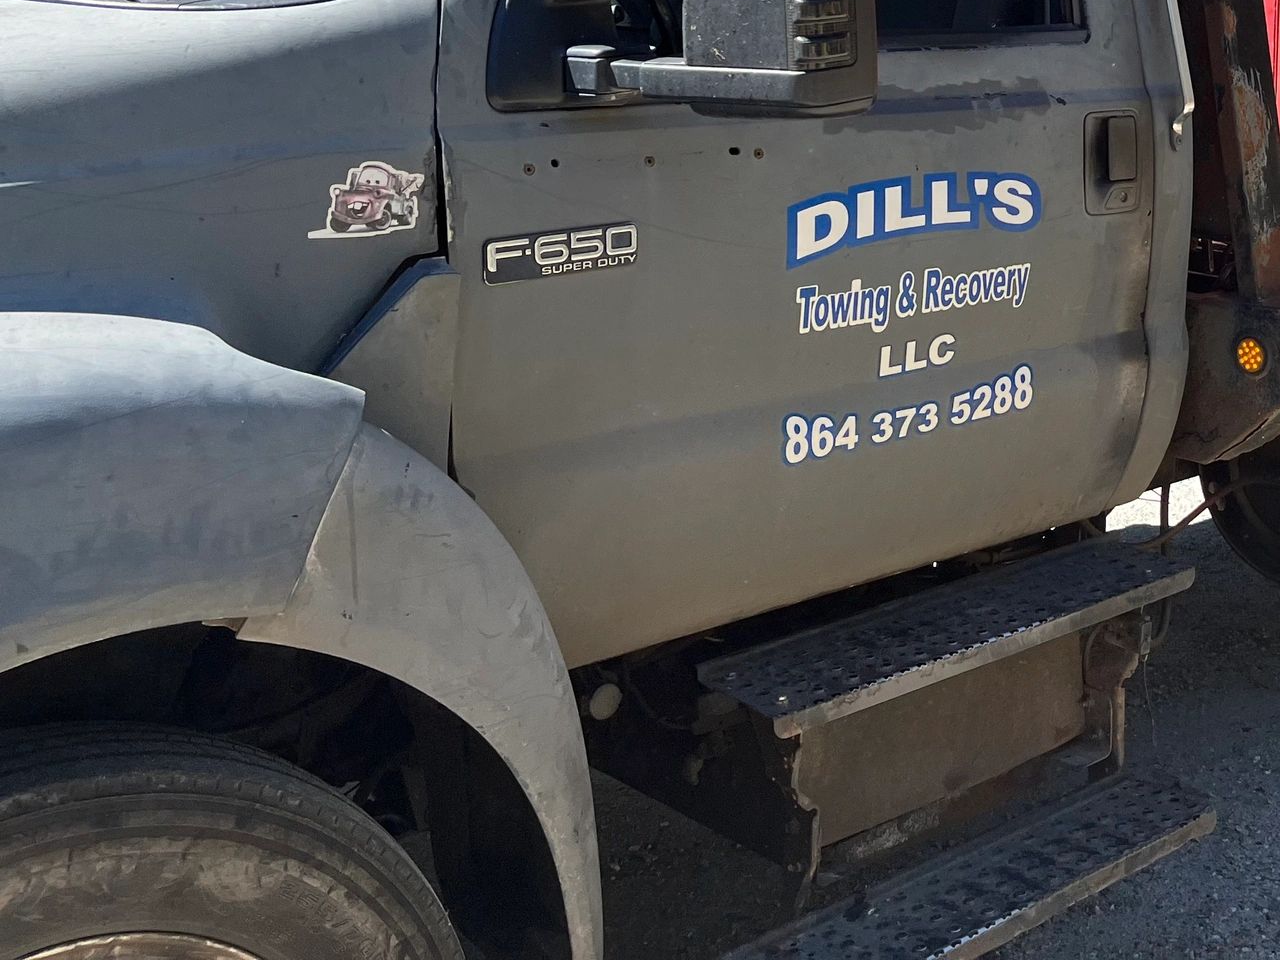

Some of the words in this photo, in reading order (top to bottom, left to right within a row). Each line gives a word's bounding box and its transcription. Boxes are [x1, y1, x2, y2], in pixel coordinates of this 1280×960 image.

[793, 176, 1037, 263] DILL'S
[541, 260, 593, 276] SUPER
[598, 253, 637, 268] DUTY
[796, 278, 892, 334] Towing
[896, 270, 917, 318] &
[922, 263, 1031, 313] Recovery
[878, 333, 956, 377] LLC
[784, 414, 859, 465] 864
[871, 402, 939, 444] 373
[950, 365, 1034, 426] 5288
